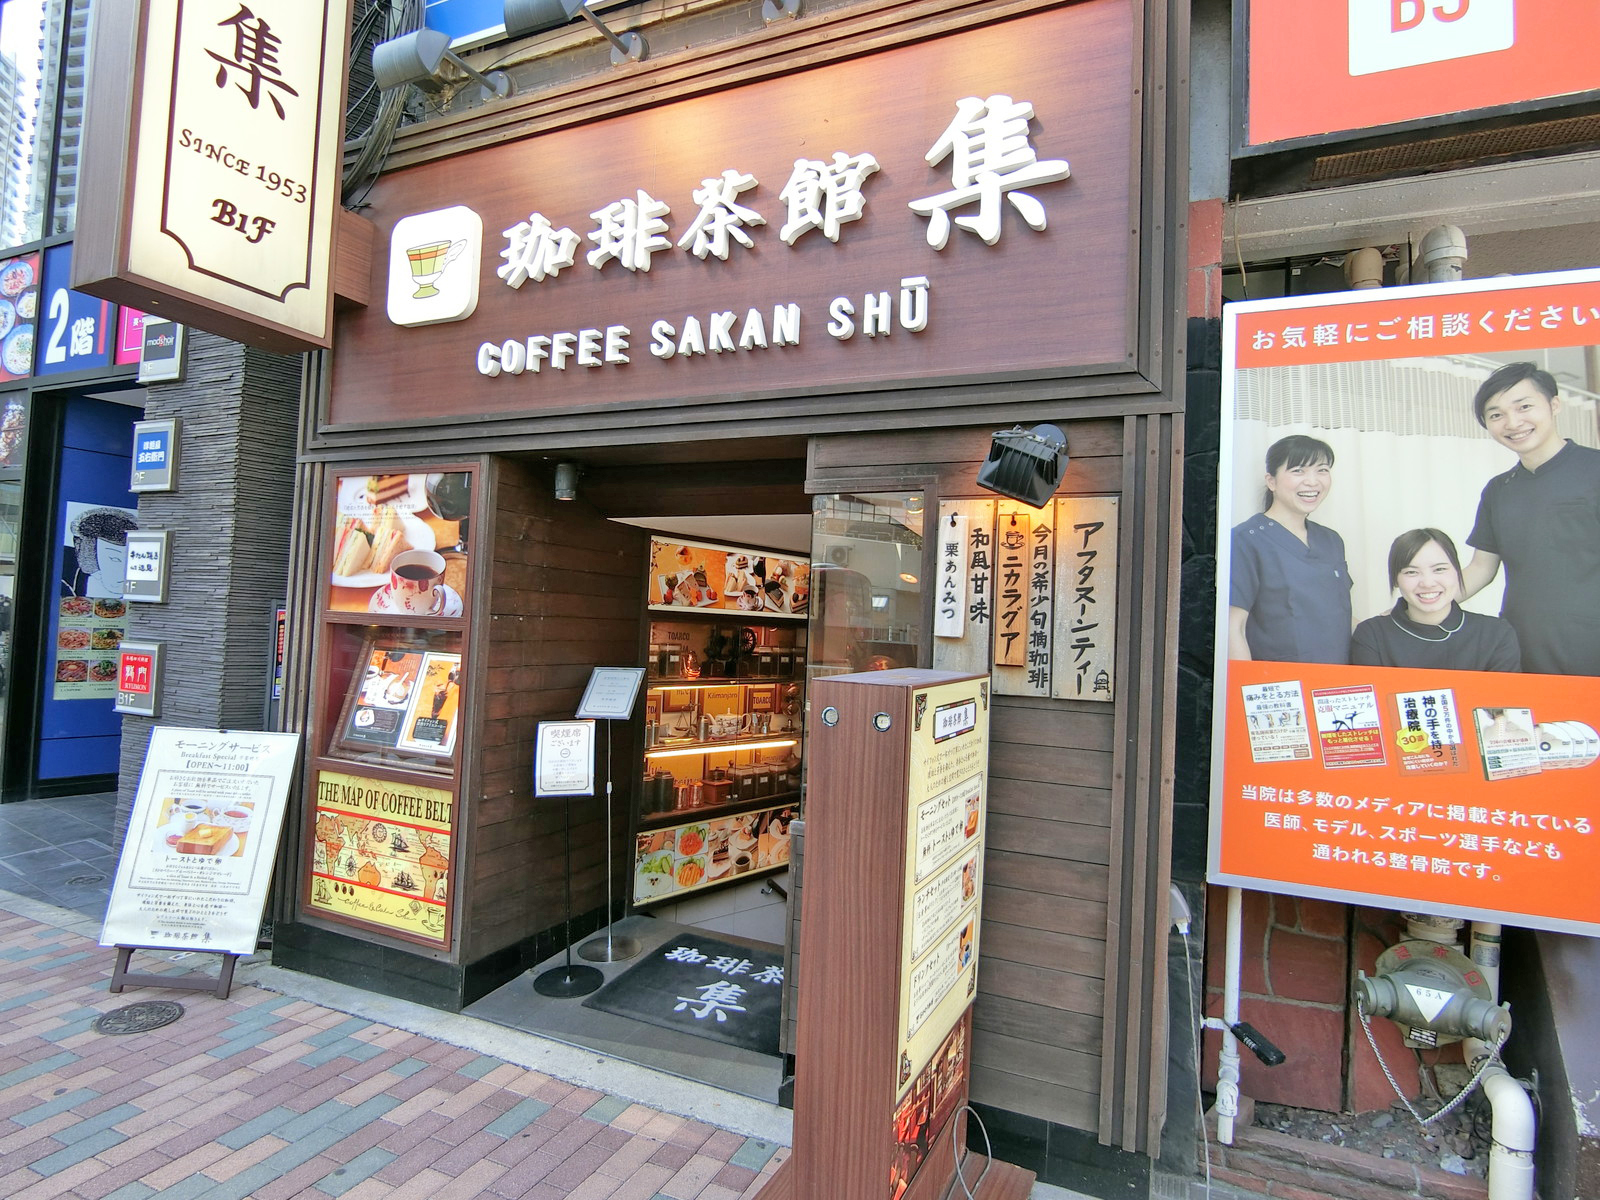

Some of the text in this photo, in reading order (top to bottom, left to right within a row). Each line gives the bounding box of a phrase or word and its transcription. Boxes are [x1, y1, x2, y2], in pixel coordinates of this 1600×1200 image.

[203, 2, 299, 121] 集
[179, 128, 308, 204] SINCE 1953
[497, 95, 1071, 289] 珈琲茶館 集
[45, 288, 95, 365] 2階
[477, 325, 630, 378] COFFEE
[650, 303, 801, 359] SAKAN
[1252, 305, 1600, 351] お気軽にご相談ください
[134, 471, 145, 484] 2F
[126, 581, 137, 593] 1F
[941, 543, 960, 620] 栗あんみつ
[969, 527, 990, 624] 和風甘味
[1000, 556, 1023, 659] ニカラグア
[1028, 523, 1052, 689] 今月の希少旬摘珈琲
[1071, 521, 1104, 696] アフタヌーンティー
[118, 692, 136, 706] B1F
[1246, 690, 1299, 701] 痛みをとる方法
[1403, 697, 1421, 732] 治療院
[175, 740, 271, 754] モーニングサービス
[551, 728, 581, 738] 喫煙席
[1422, 695, 1443, 758] 神の手を持つ
[181, 752, 211, 760] Breakfast
[212, 753, 237, 762] Special
[319, 781, 452, 823] THE MAP OF COFFEE BELT
[1241, 784, 1592, 834] 当院は多数のメディアに掲載されている
[1264, 811, 1561, 860] 医師、モデル、スポーツ選手なども
[165, 856, 223, 864] トーストとゆで卵
[1312, 842, 1501, 883] 通われる整骨院です。
[674, 980, 748, 1023] 集
